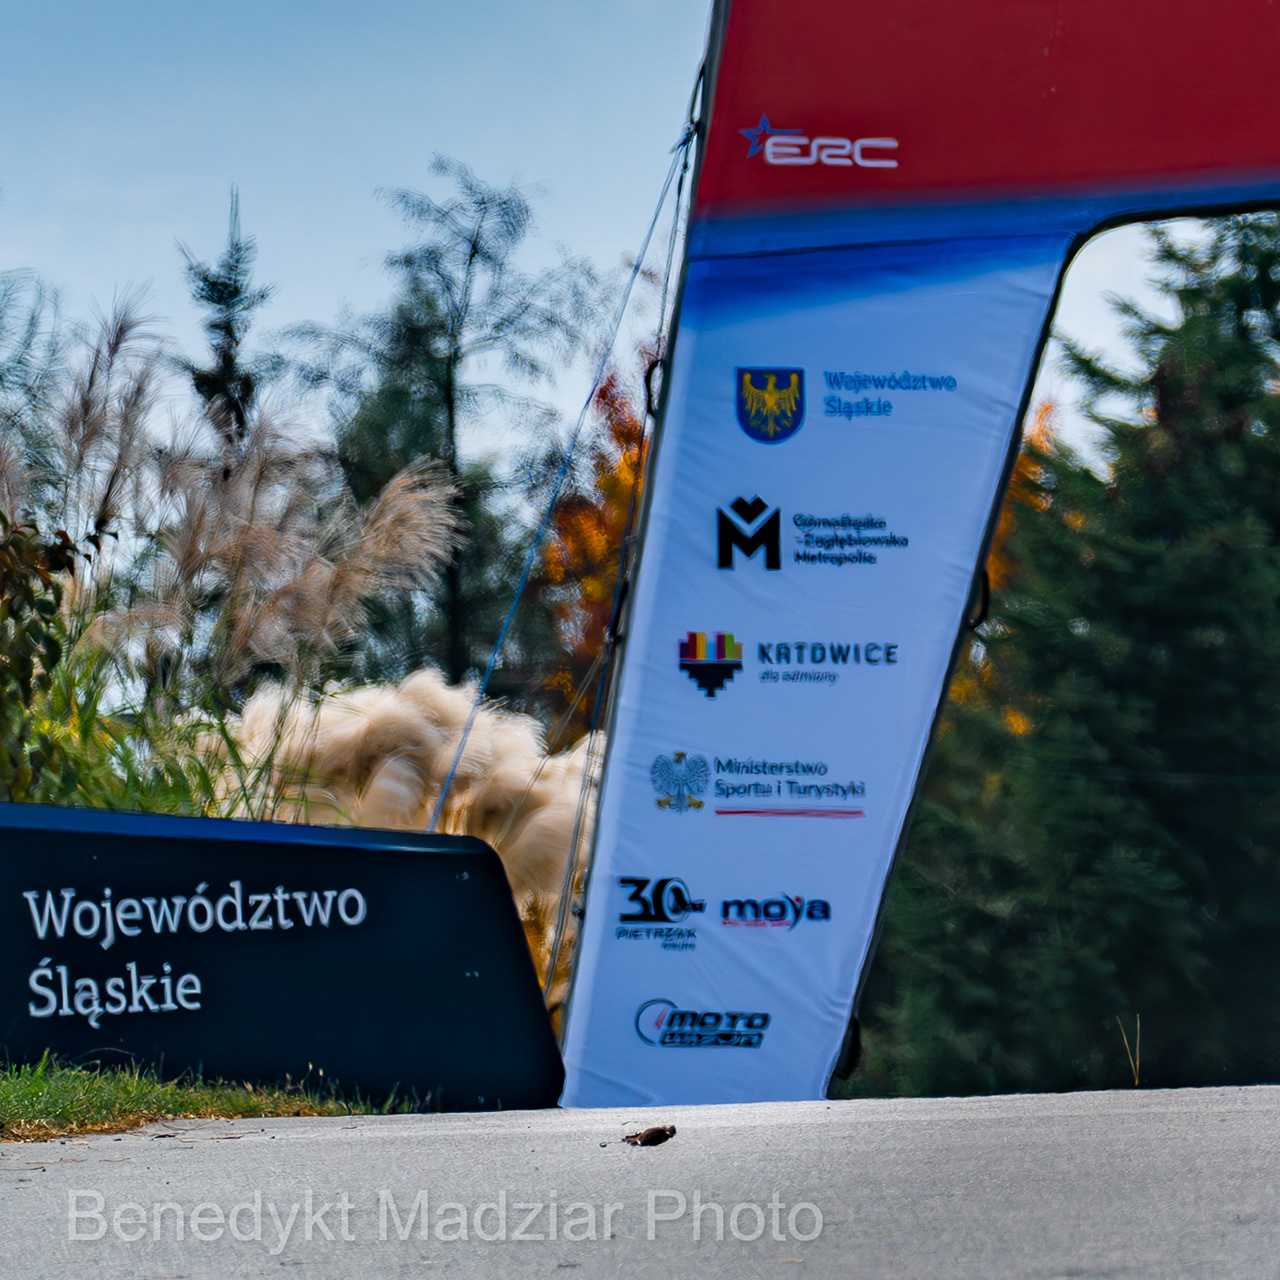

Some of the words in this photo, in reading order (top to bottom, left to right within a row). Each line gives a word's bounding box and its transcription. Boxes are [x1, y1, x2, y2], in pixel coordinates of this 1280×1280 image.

[764, 137, 899, 168] ERC
[758, 641, 899, 665] KATOWICE
[23, 881, 367, 950] Województwo
[620, 877, 690, 923] 30
[27, 959, 202, 1028] Śląskie
